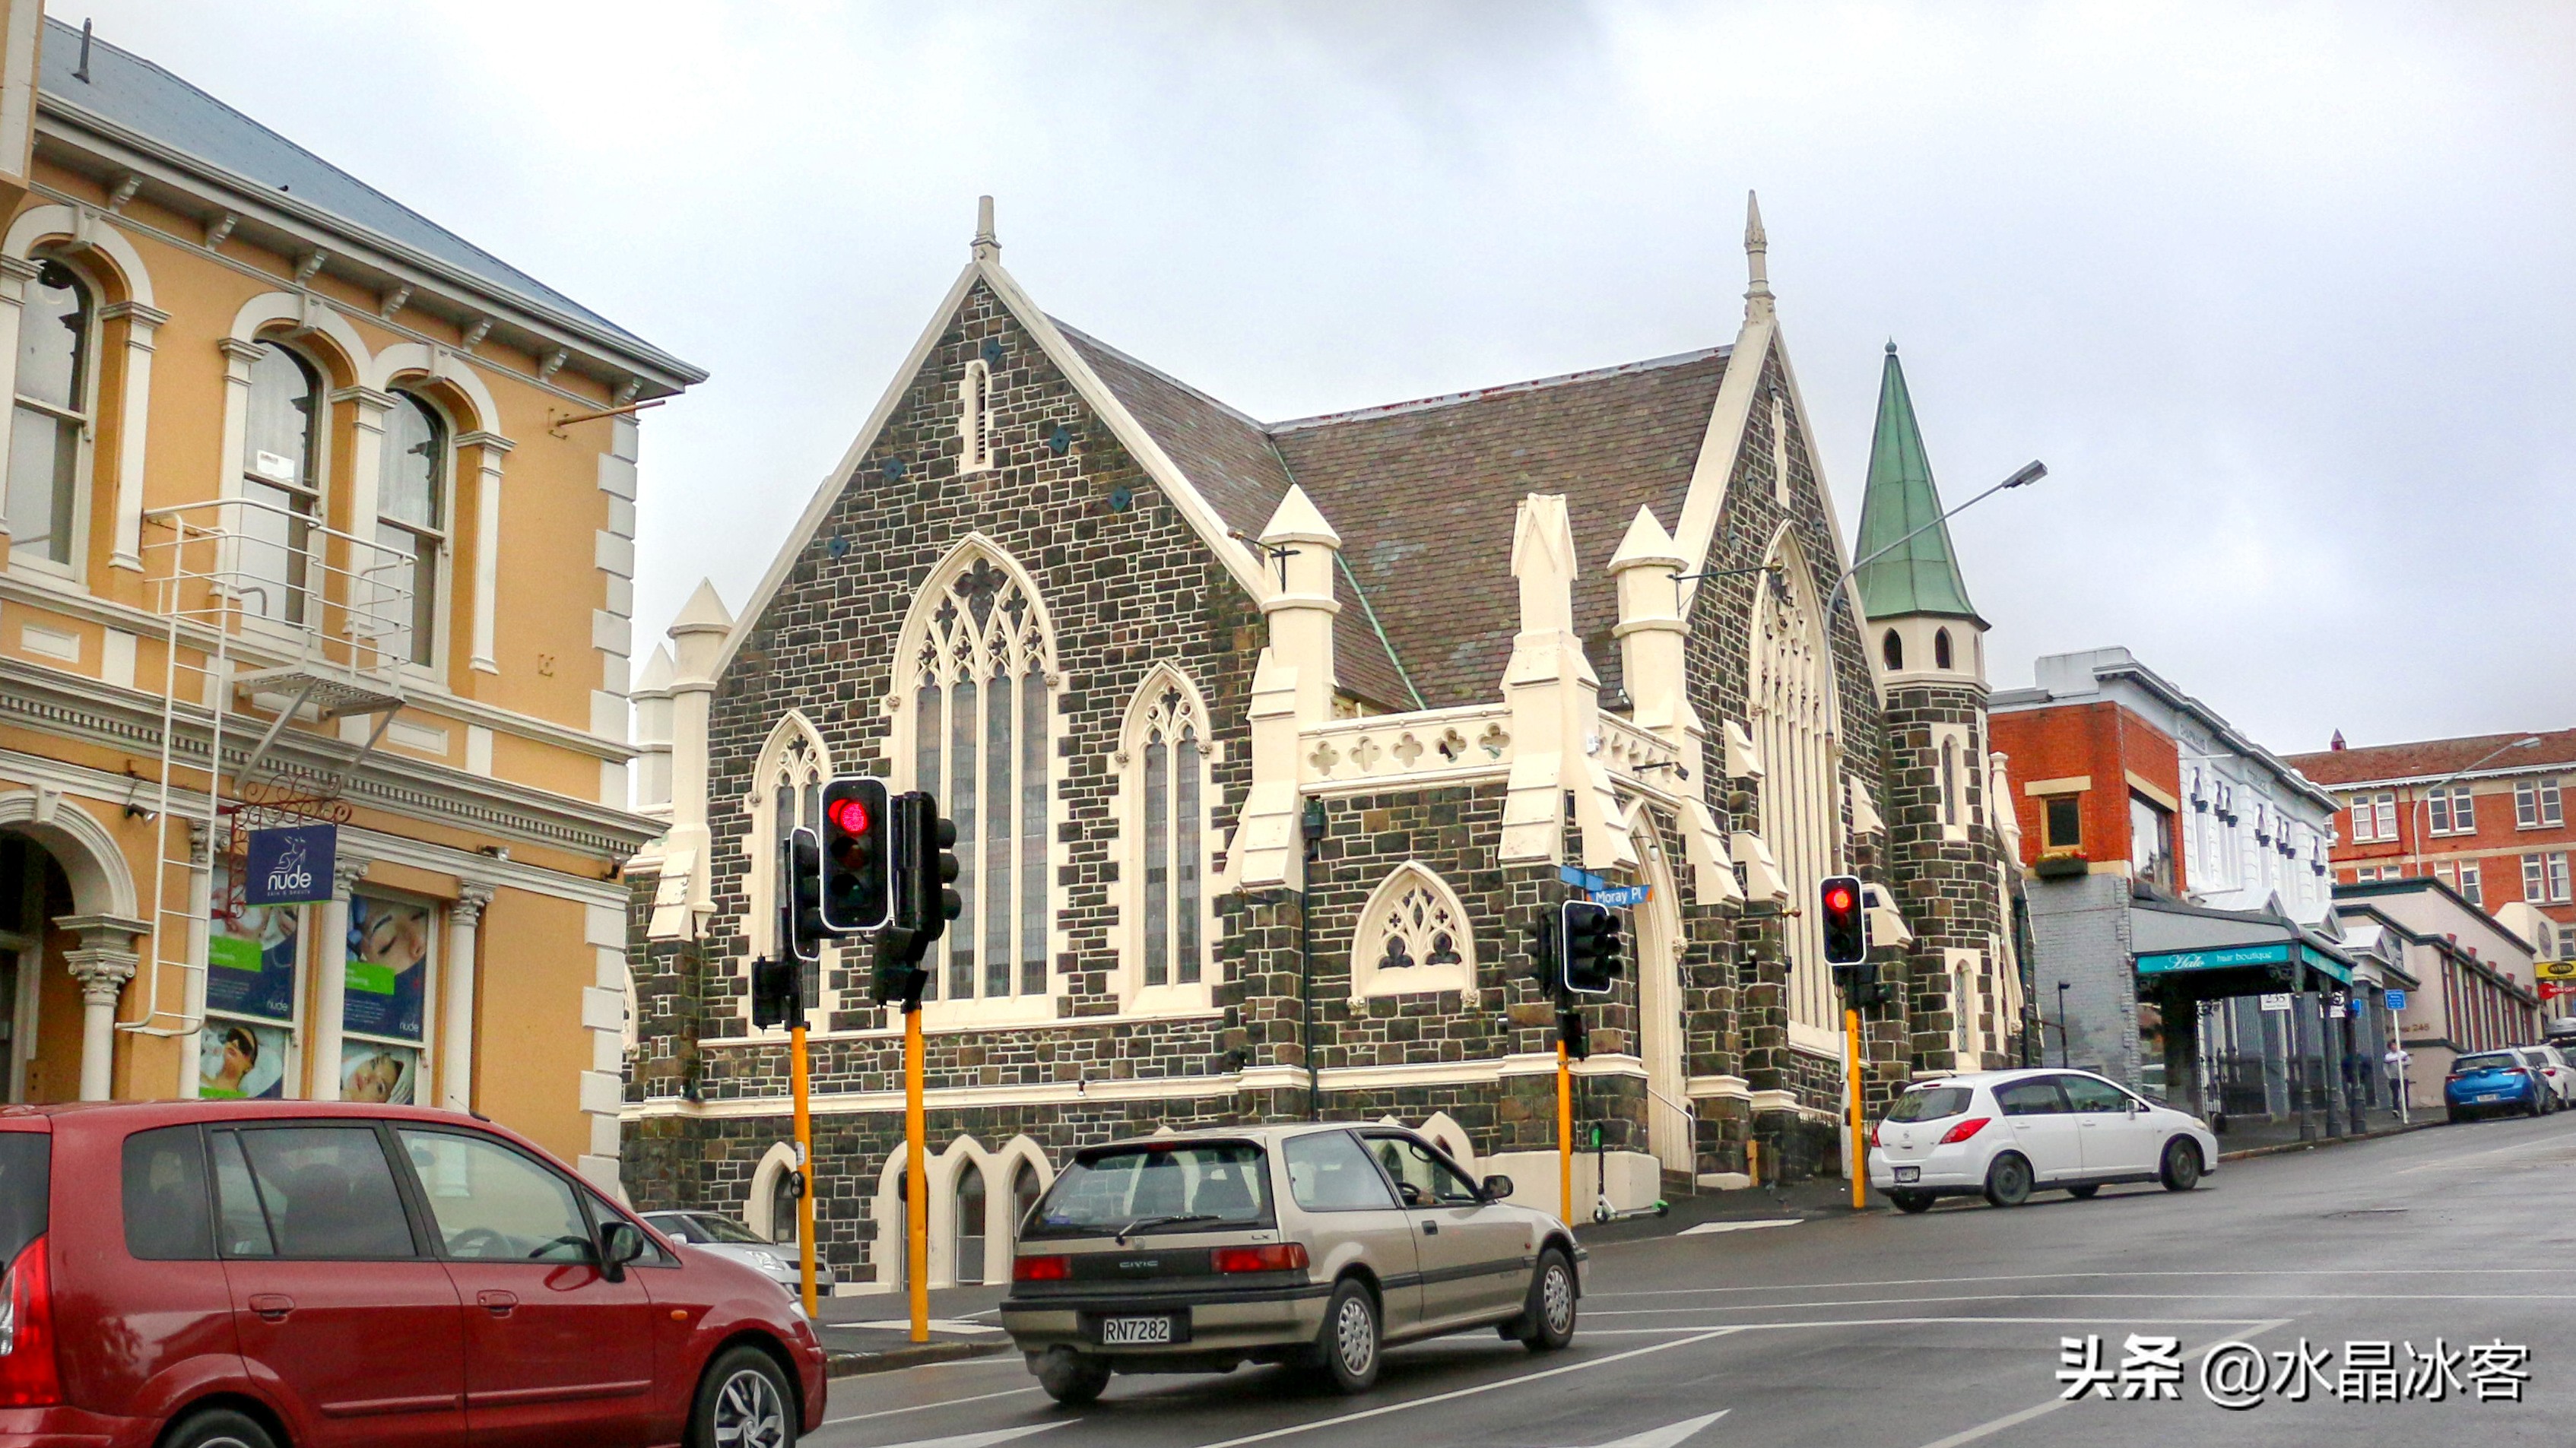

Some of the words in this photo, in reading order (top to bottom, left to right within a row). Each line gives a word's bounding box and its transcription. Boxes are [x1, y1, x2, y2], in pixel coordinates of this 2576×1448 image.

[268, 864, 312, 890] nude
[1596, 891, 1628, 904] Moray
[1631, 886, 1642, 900] Pl
[2216, 953, 2233, 962] hair
[2235, 951, 2273, 962] boutique
[267, 998, 288, 1012] nude
[399, 1019, 420, 1032] nude
[1105, 1320, 1168, 1341] RN7282
